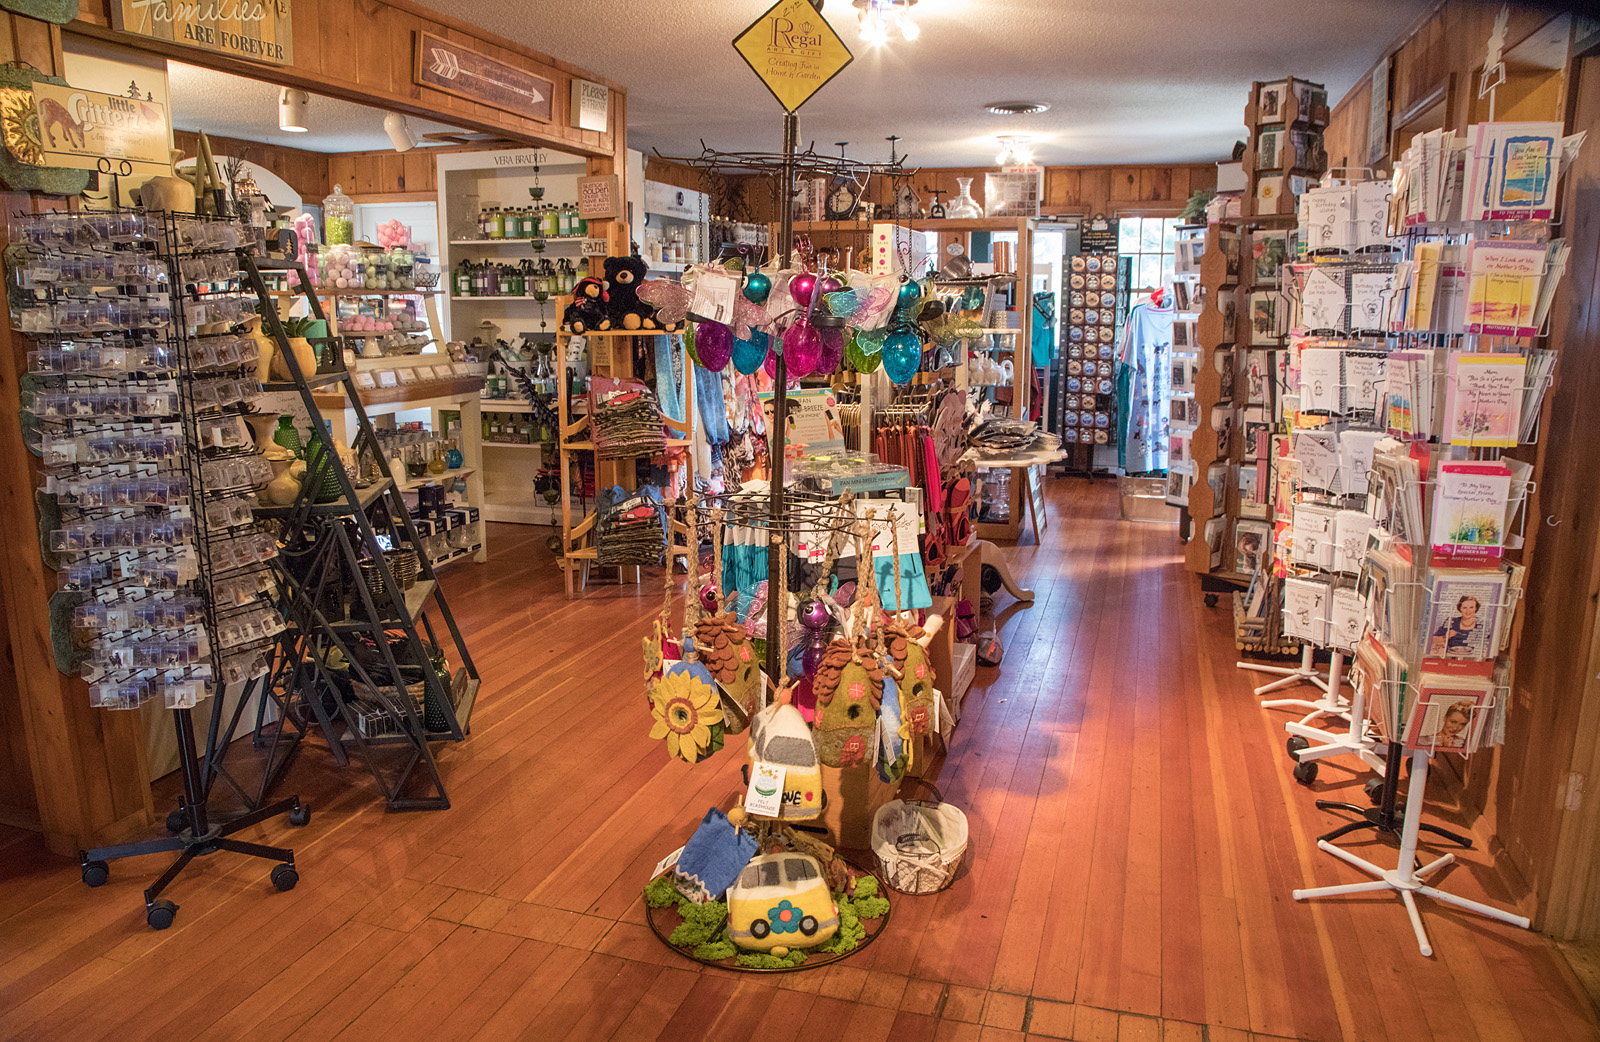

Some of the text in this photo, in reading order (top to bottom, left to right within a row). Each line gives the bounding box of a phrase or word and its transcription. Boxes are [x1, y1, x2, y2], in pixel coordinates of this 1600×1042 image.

[767, 16, 822, 49] Regal
[184, 23, 284, 60] ARE FOREVER
[768, 57, 798, 71] Creating
[800, 61, 812, 69] Fun
[766, 67, 787, 77] Home
[796, 72, 820, 80] Garden
[67, 92, 140, 132] Critterz
[108, 96, 136, 113] little
[494, 153, 548, 166] VERA BRADLEY
[782, 791, 802, 804] OVE
